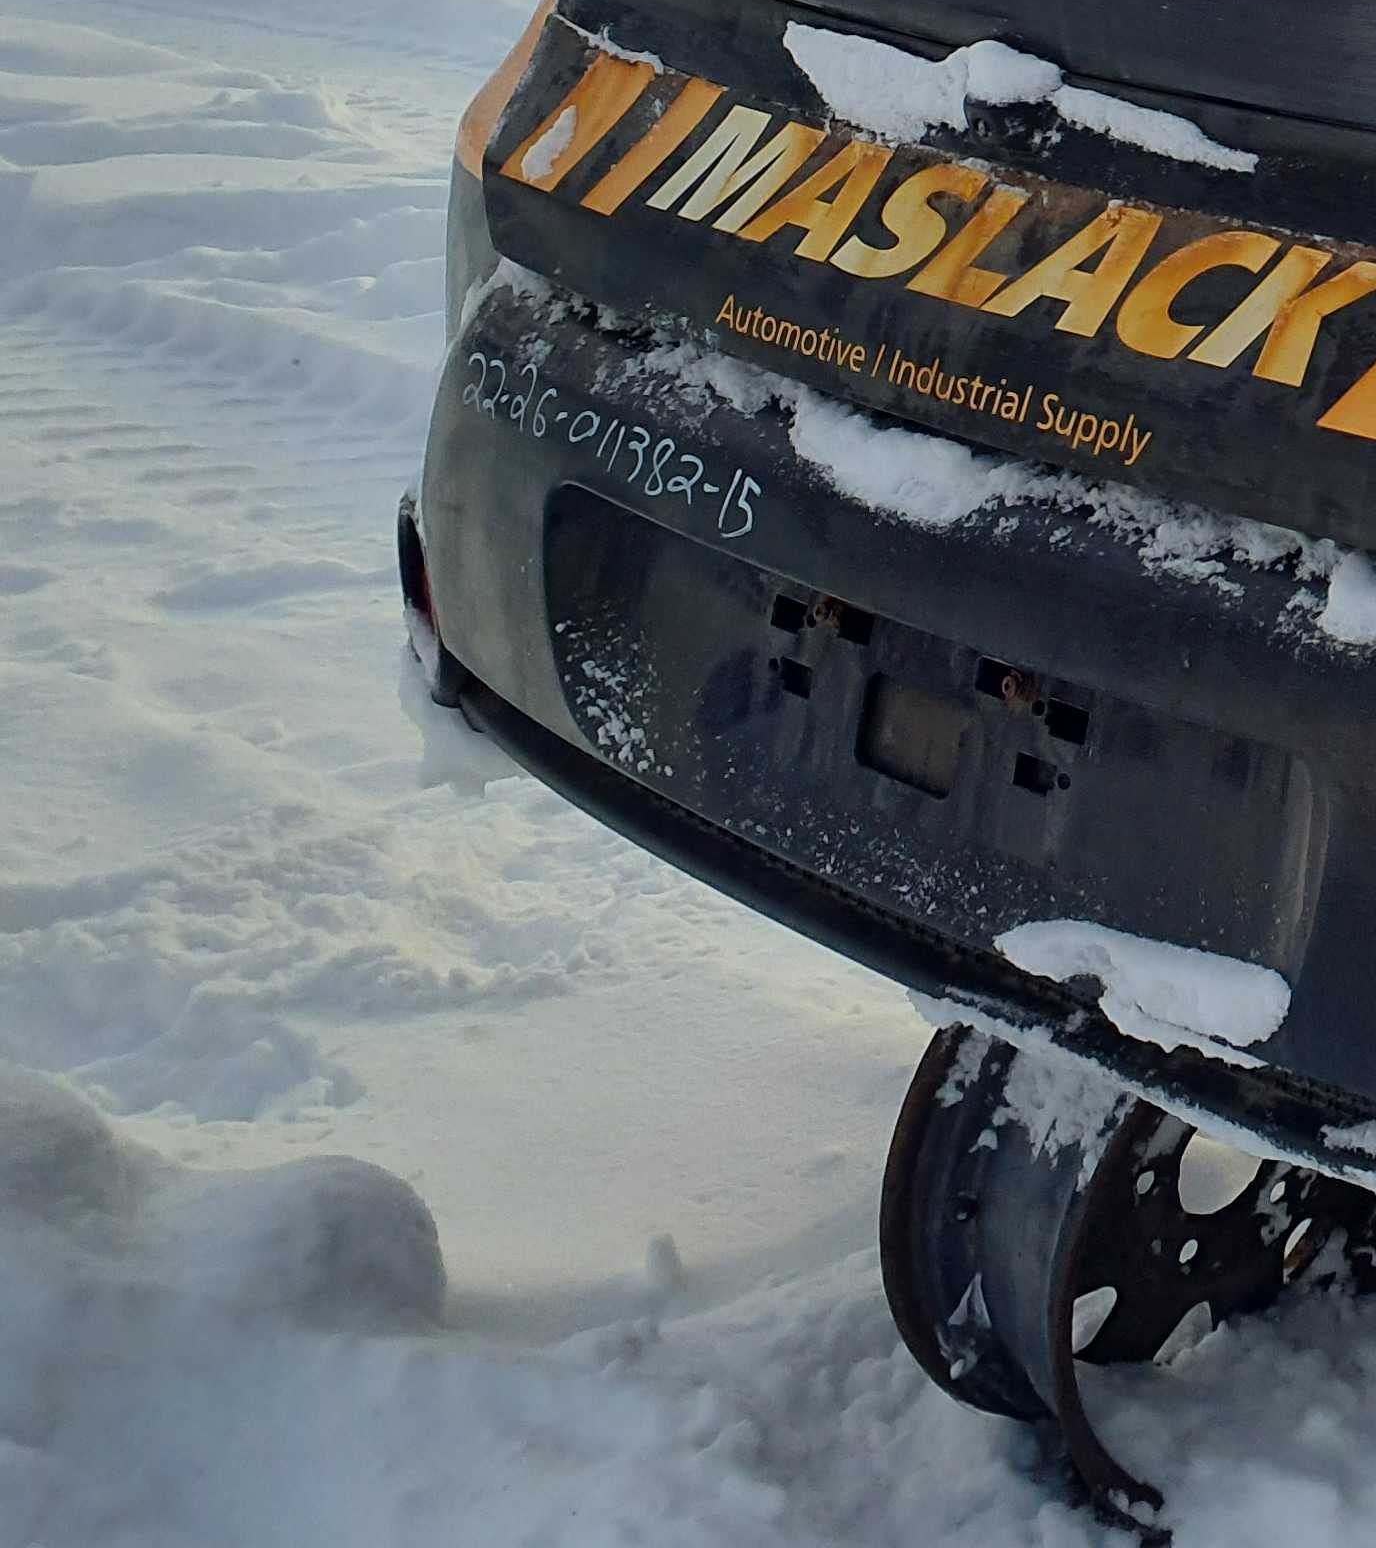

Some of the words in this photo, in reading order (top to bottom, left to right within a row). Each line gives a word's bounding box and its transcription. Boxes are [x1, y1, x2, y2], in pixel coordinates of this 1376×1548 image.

[463, 352, 761, 538] 22-26-011382-15
[715, 294, 866, 374] Automotive
[888, 349, 1034, 423] Industrial
[1036, 393, 1153, 466] Supply
